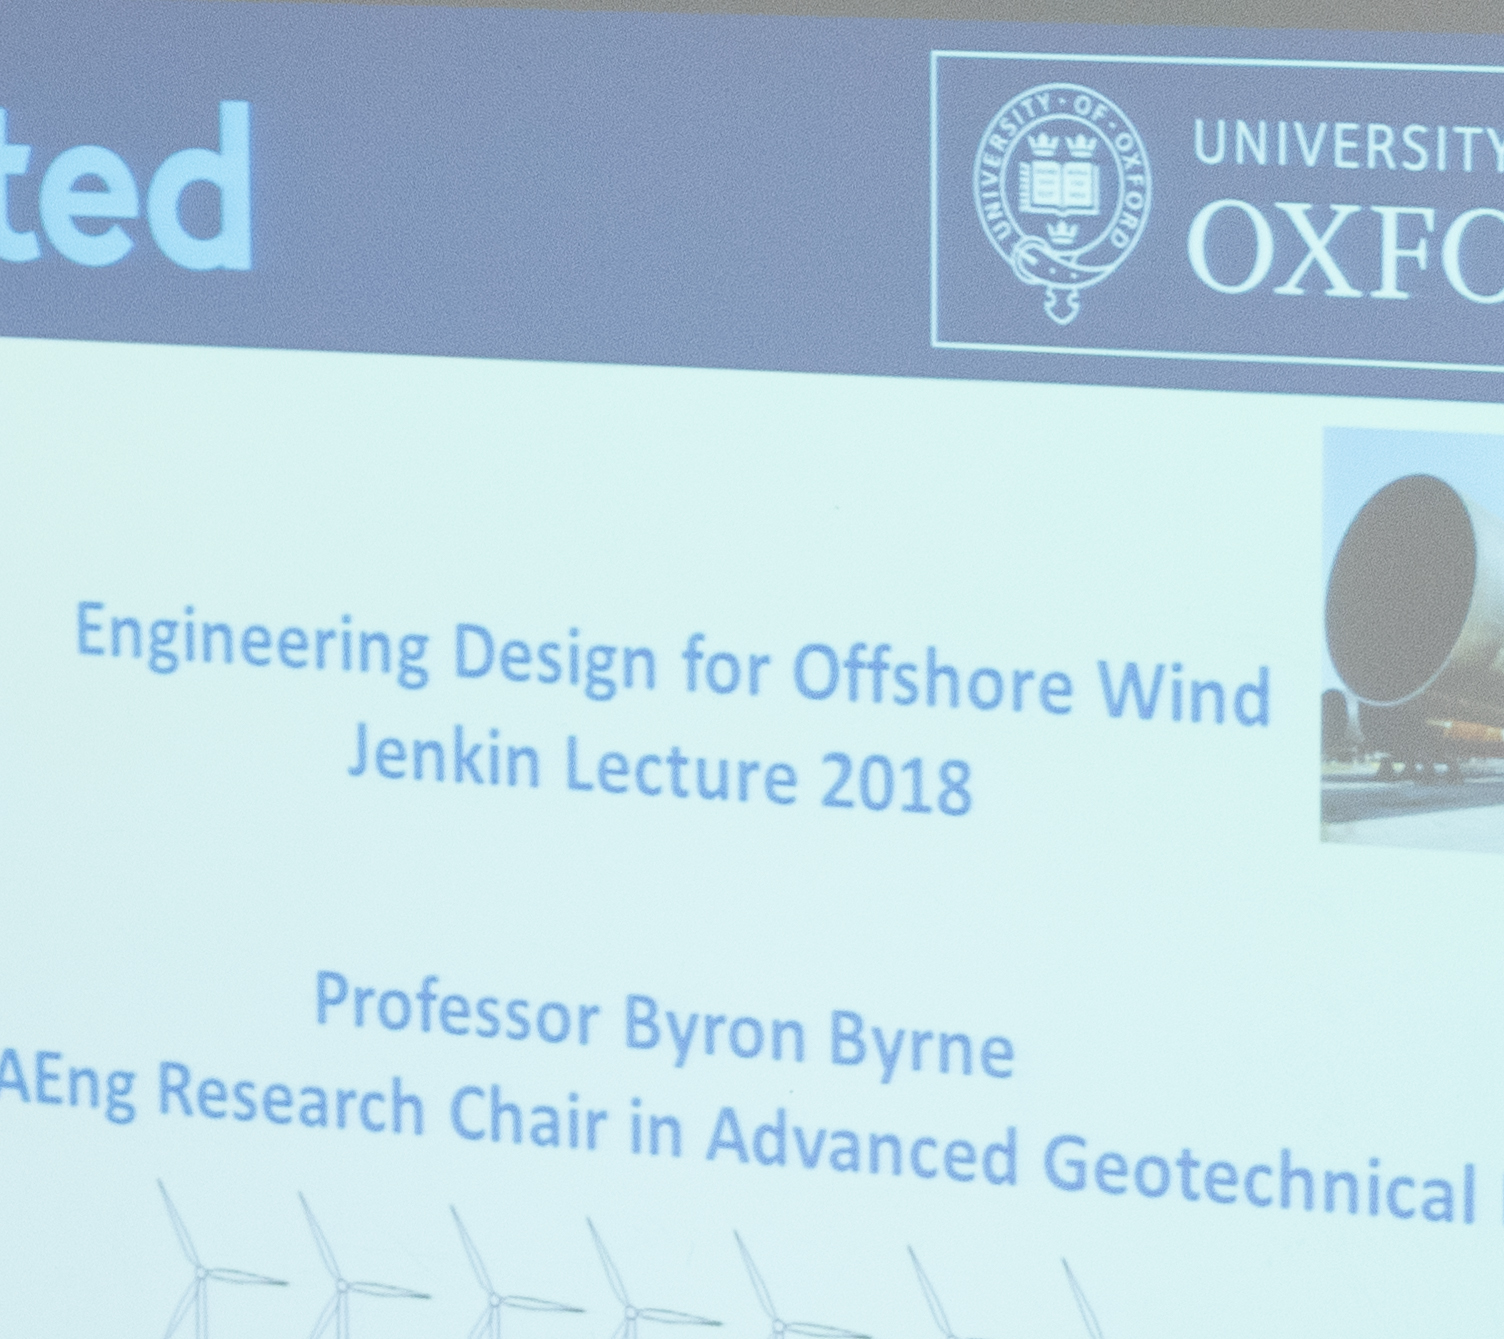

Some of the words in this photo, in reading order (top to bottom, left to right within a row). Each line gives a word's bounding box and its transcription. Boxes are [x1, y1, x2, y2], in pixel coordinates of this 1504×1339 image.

[980, 92, 1050, 241] UNIVERSITY
[1074, 95, 1108, 121] OF
[1111, 132, 1144, 248] OXFORD
[76, 602, 429, 690] Engineering
[454, 623, 657, 701] Design
[683, 634, 770, 696] for
[794, 643, 1074, 715] Offshore
[1098, 660, 1271, 727] Wind
[347, 721, 539, 788] Jenkin
[566, 736, 797, 806] Lecture
[822, 751, 972, 817] 2018
[316, 971, 599, 1046] Professor
[625, 994, 805, 1067] Byron
[830, 1010, 1015, 1084] Byrne
[159, 1062, 423, 1136] Research
[450, 1085, 606, 1150] Chair
[630, 1099, 681, 1158] in
[706, 1106, 1017, 1185] Advanced
[1043, 1134, 1476, 1223] Geotechnical
